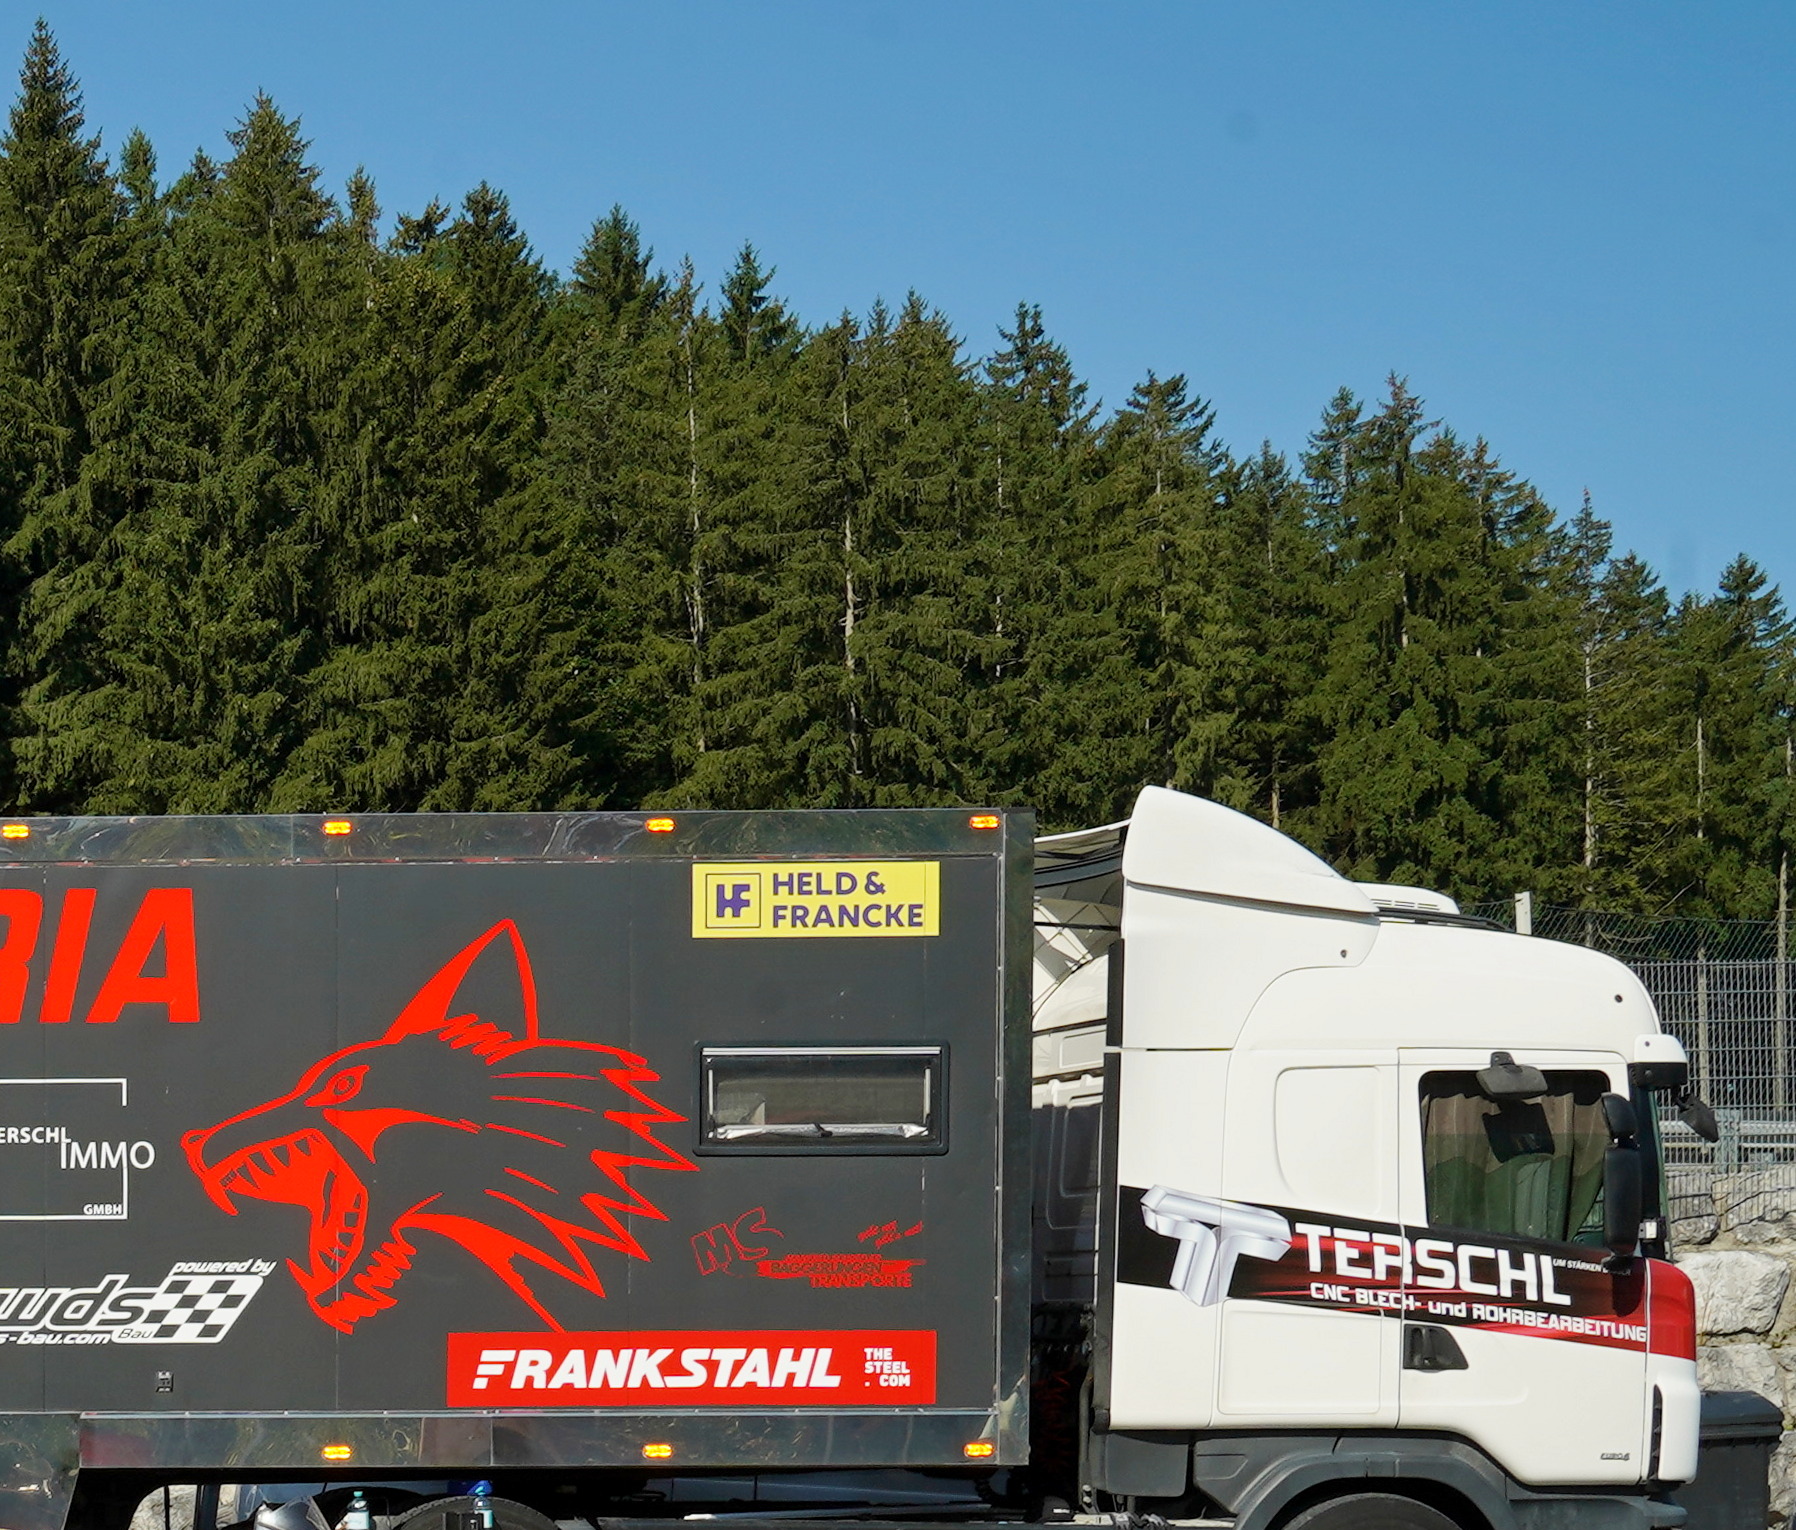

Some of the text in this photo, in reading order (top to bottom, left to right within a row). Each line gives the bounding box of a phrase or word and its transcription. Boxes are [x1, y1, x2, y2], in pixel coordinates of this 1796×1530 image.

[772, 871, 886, 896] HELD &
[772, 903, 924, 929] FRANCKE
[60, 1141, 156, 1170] IMMO
[83, 1204, 123, 1216] GMBH
[169, 1258, 277, 1276] powered by
[1295, 1223, 1572, 1306] TERSCHL
[809, 1274, 913, 1288] TRANSPORTE
[1310, 1282, 1647, 1344] CNC BLECH- und ROHRBEARBEITUNG
[865, 1347, 893, 1361] THE
[472, 1347, 842, 1390] FRANKSTAHL
[864, 1360, 910, 1374] STEEL
